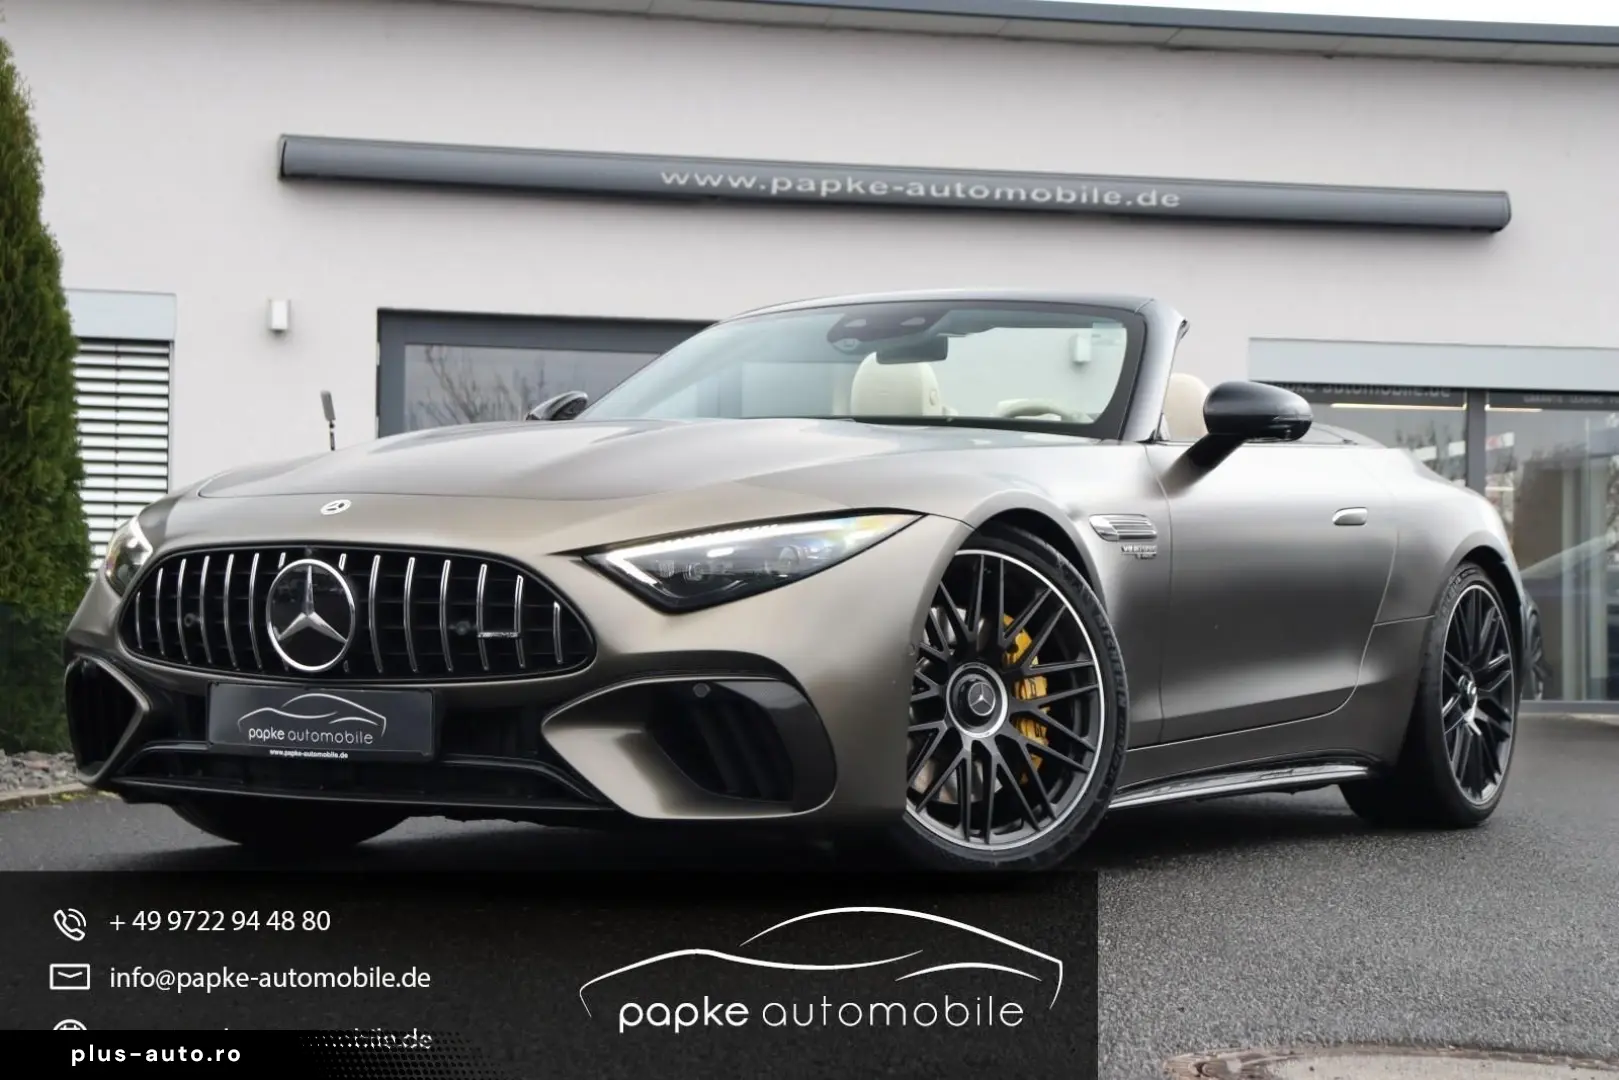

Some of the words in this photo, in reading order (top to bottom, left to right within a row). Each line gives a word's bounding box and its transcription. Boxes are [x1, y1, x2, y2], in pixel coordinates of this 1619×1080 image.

[660, 168, 1182, 209] www.papke-automobile.de
[248, 726, 285, 742] papke
[287, 729, 374, 745] automobile
[269, 748, 349, 759] www.papke-automobile.de
